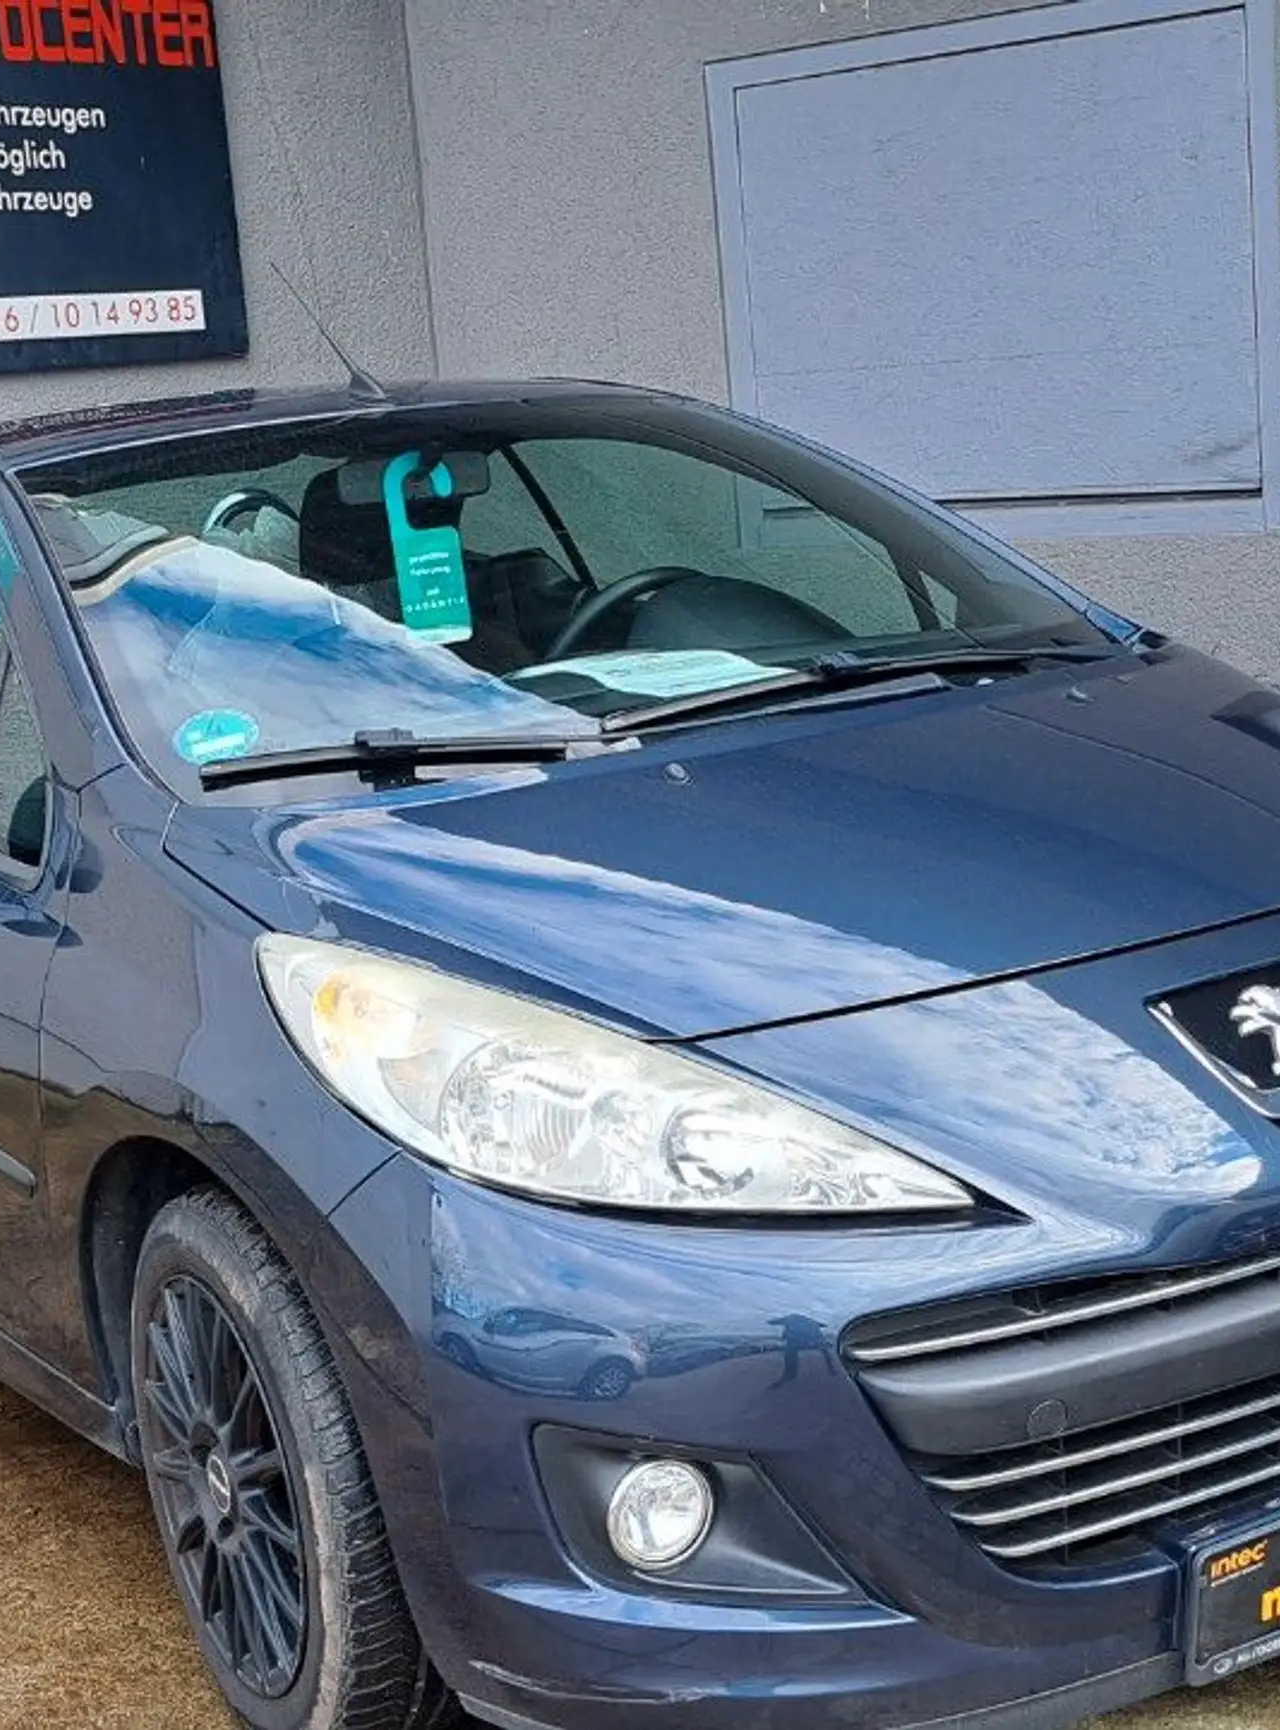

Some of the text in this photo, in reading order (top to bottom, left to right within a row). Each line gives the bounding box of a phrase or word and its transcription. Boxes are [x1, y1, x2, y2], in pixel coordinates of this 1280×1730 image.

[50, 302, 81, 328] 10
[93, 301, 120, 326] 14
[128, 298, 159, 324] 93
[167, 296, 197, 321] 85
